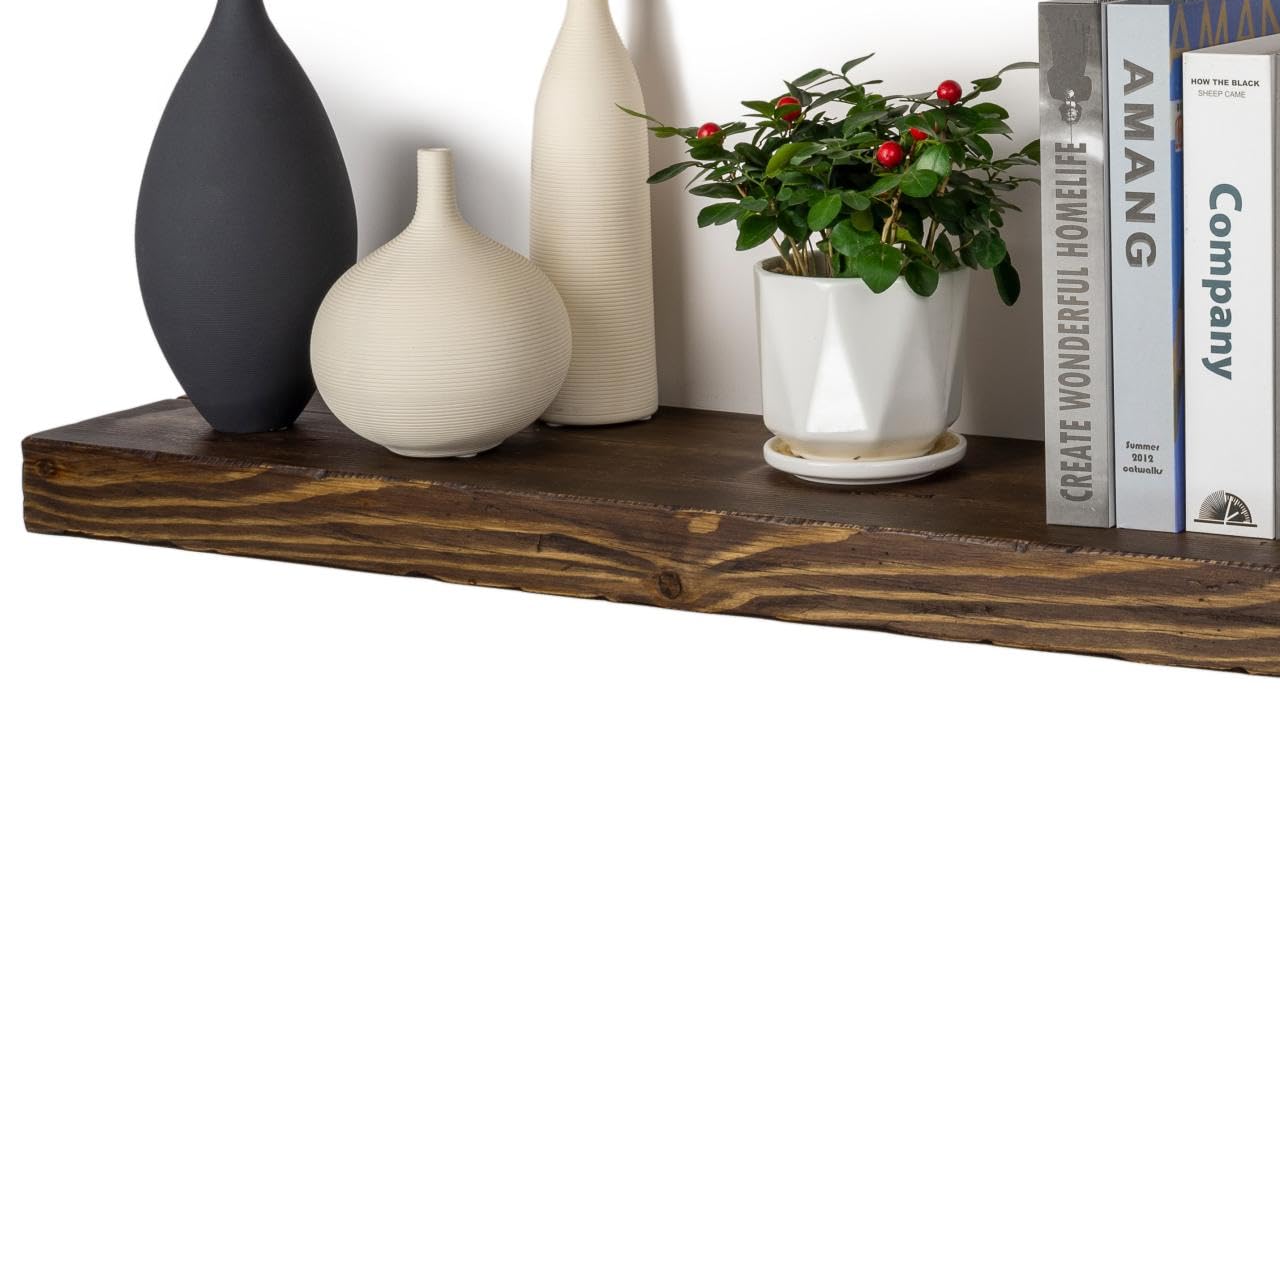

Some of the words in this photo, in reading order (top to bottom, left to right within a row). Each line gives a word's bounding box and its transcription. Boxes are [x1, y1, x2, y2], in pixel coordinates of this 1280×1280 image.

[1191, 78, 1210, 86] HOW
[1198, 89, 1223, 97] SHEEP
[1224, 91, 1247, 99] CAME
[1054, 142, 1089, 258] HOMELIFE
[1122, 58, 1157, 268] AMANG
[1201, 183, 1243, 381] Company
[1056, 267, 1092, 412] WONDERFUL
[1058, 419, 1094, 503] CREATE
[1125, 440, 1160, 451] Summer
[1131, 453, 1154, 463] 2012
